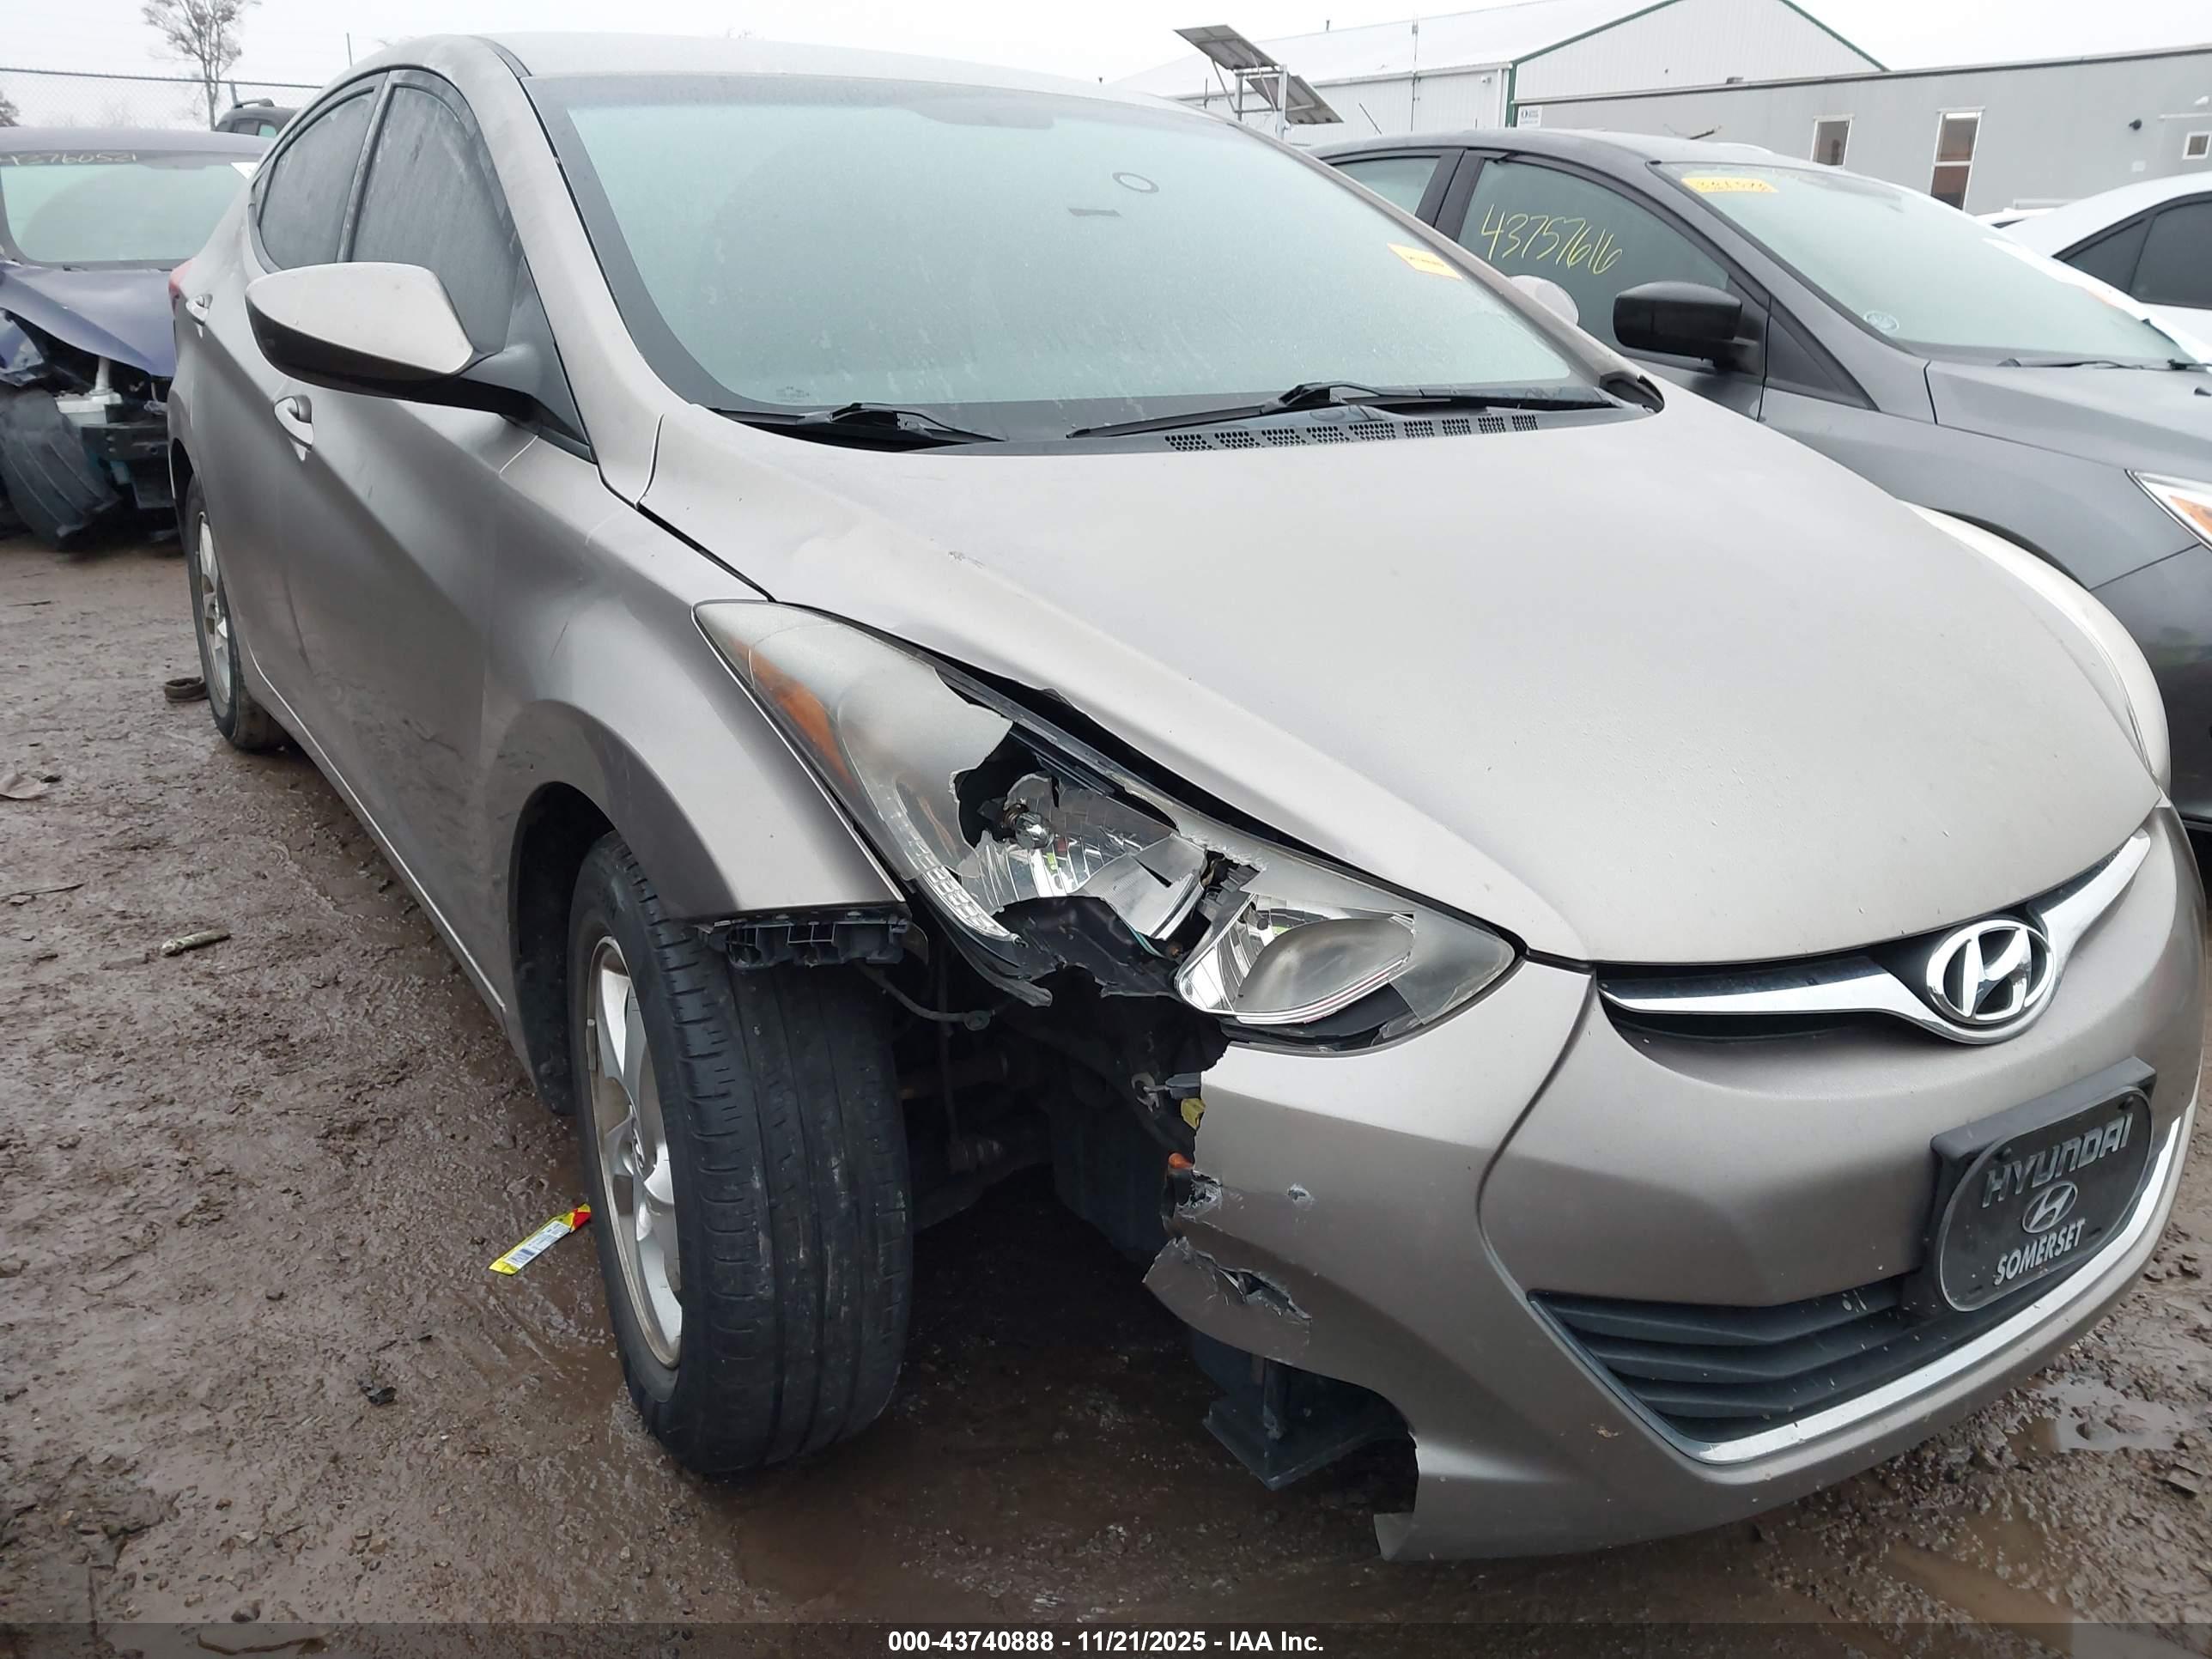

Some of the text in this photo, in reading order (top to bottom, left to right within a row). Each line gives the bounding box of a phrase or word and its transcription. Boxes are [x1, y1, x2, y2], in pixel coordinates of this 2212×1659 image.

[1480, 204, 1623, 275] 43757616
[1981, 1112, 2134, 1209] HYUNDAI
[1993, 1218, 2087, 1286] SOMERSET
